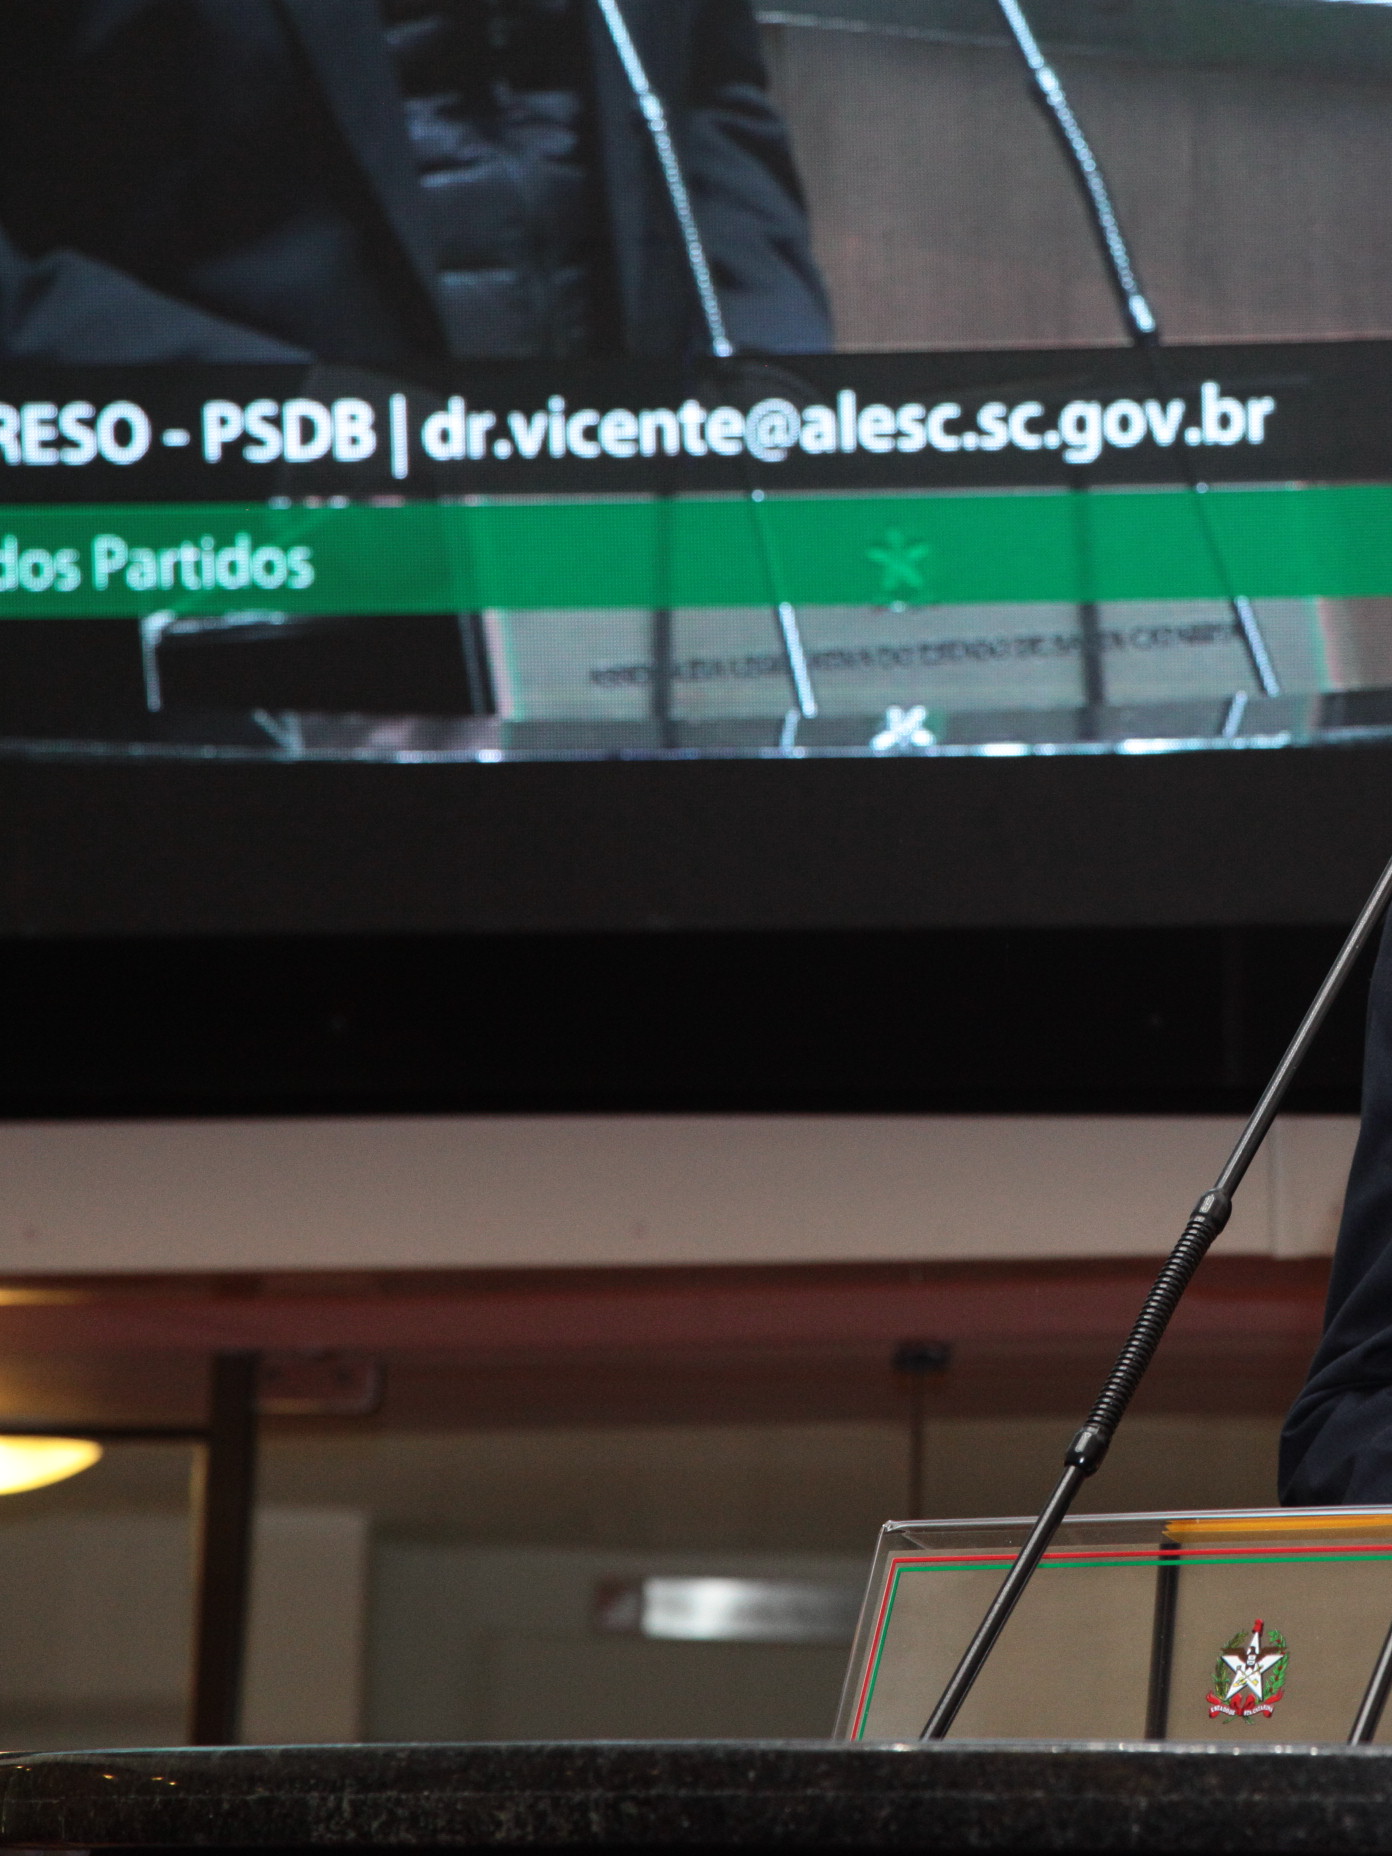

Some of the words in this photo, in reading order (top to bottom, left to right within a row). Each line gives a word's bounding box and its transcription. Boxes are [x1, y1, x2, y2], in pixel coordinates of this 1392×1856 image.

[202, 397, 378, 464] PSDB
[421, 381, 1275, 465] dr.vicente@alesc.sc.gov.br
[92, 532, 315, 591] Partidos
